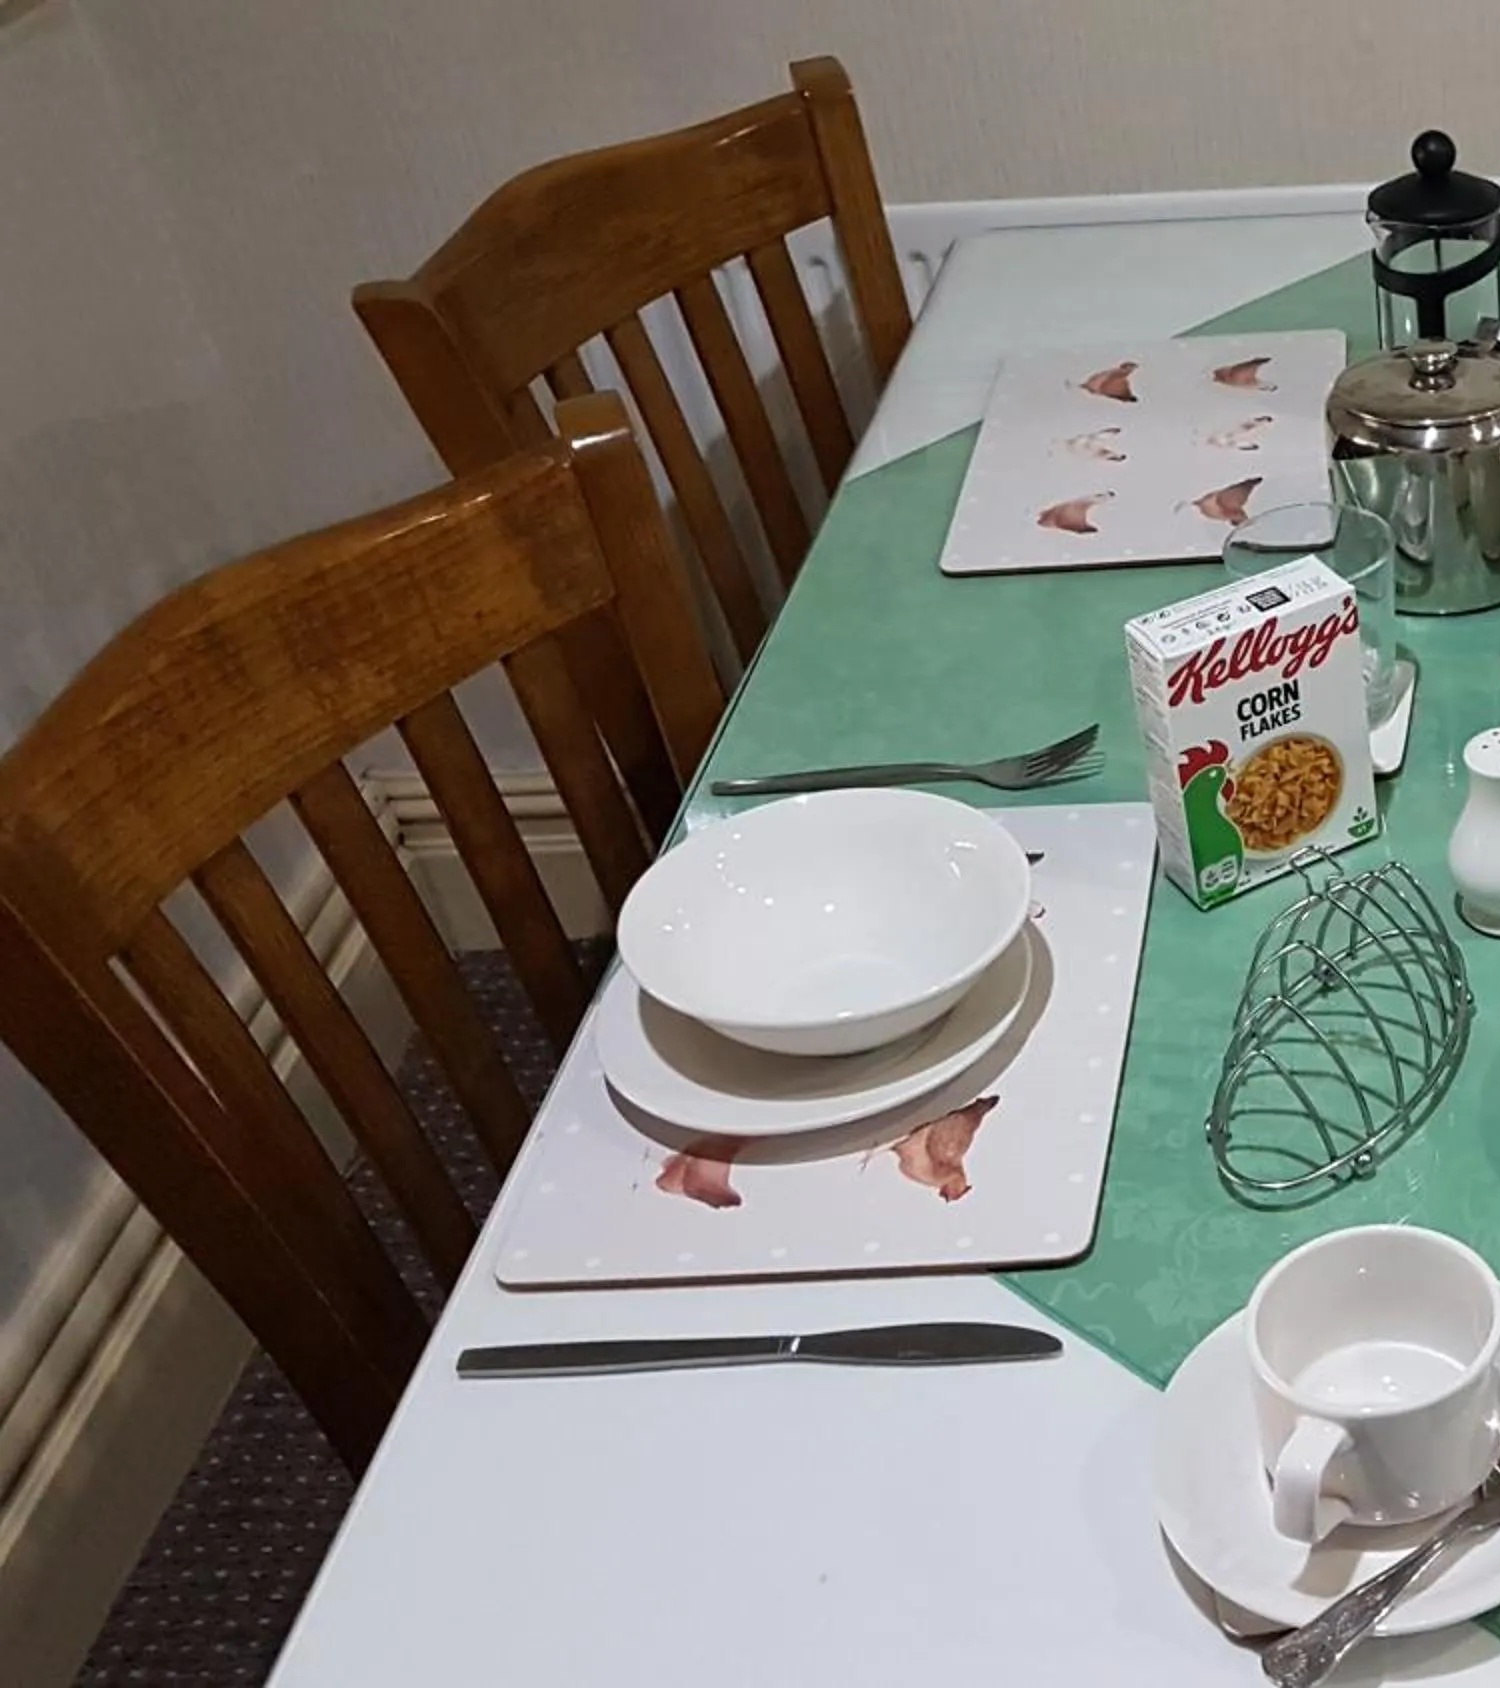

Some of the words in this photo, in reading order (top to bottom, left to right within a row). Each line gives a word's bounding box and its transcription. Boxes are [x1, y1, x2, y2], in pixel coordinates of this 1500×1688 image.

[1167, 596, 1360, 707] Kellogg's
[1236, 679, 1300, 722] CORN
[1240, 703, 1302, 742] FLAKES
